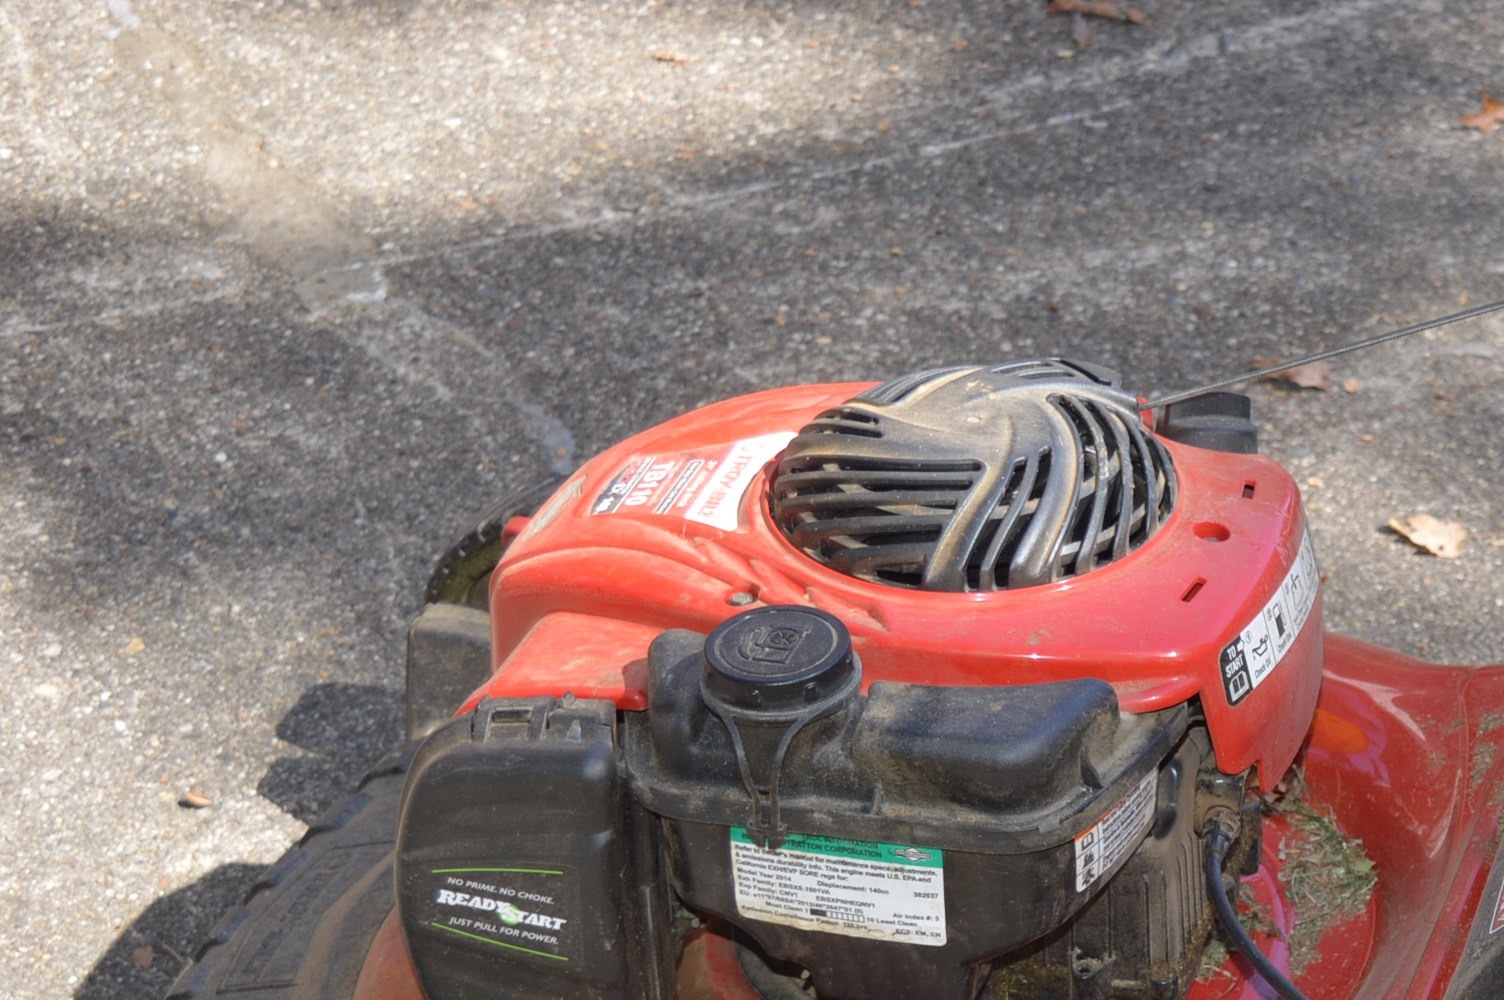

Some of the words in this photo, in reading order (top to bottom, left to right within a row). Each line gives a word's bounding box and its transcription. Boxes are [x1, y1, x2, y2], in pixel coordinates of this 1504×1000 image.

[625, 461, 675, 506] TB110
[1227, 645, 1237, 660] TO
[1225, 654, 1245, 678] START
[1254, 664, 1267, 679] Check
[824, 845, 882, 858] CORPORATION
[736, 859, 767, 870] California
[742, 853, 775, 864] emissions
[776, 858, 807, 869] durability
[825, 865, 839, 873] This
[840, 867, 864, 876] engine
[865, 871, 885, 879] meets
[887, 872, 900, 880] U.S.
[737, 867, 757, 876] Model
[759, 870, 774, 878] Year
[775, 874, 792, 882] 2014
[752, 877, 777, 887] Family:
[448, 877, 464, 886] NO
[466, 880, 498, 893] PRIME.
[499, 887, 516, 897] NO
[518, 891, 555, 904] CHOKE.
[753, 885, 778, 894] Family:
[817, 880, 867, 892] Displacement:
[868, 887, 889, 895] 140cc
[897, 919, 918, 927] Clean
[448, 917, 473, 928] JUST
[473, 921, 498, 932] PULL
[499, 927, 520, 937] FOR
[521, 931, 559, 945] POWER.
